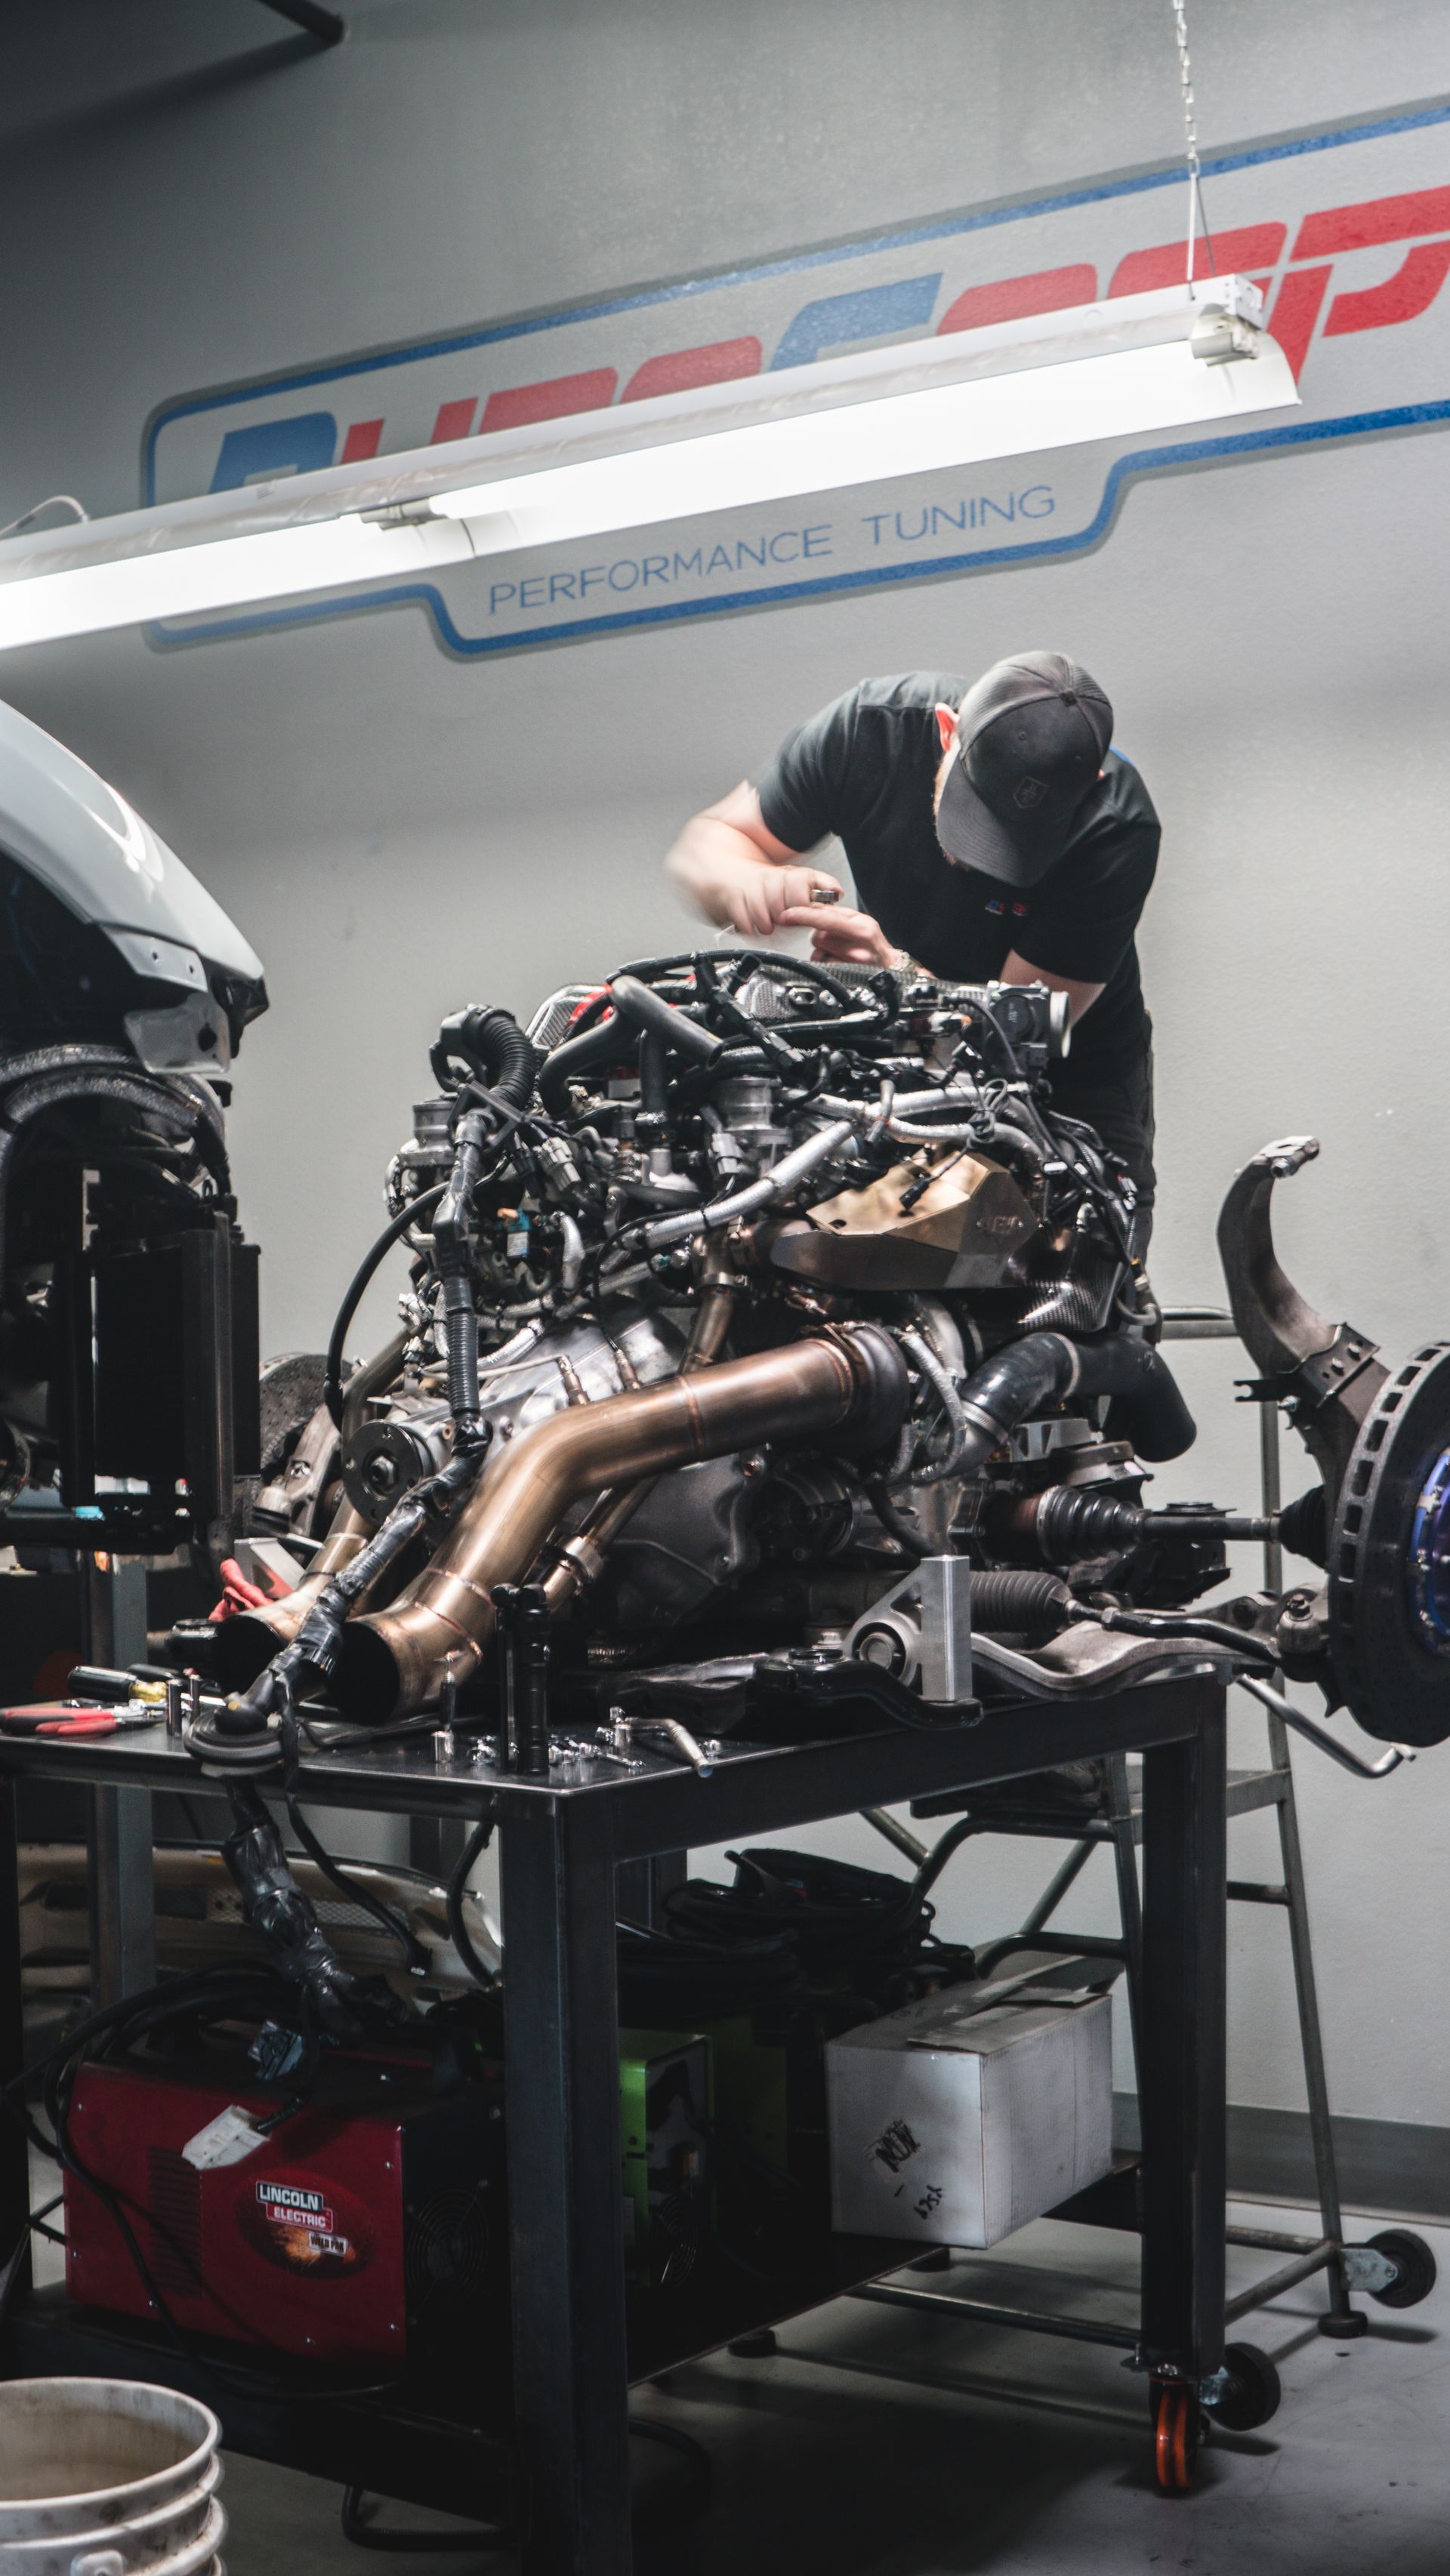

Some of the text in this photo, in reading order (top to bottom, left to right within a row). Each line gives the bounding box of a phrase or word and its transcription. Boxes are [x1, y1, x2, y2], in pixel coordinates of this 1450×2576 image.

[489, 485, 1055, 615] PERFORMANCE TUNING
[259, 2184, 319, 2211] LINCOLN
[273, 2205, 326, 2228] ELECTRIC
